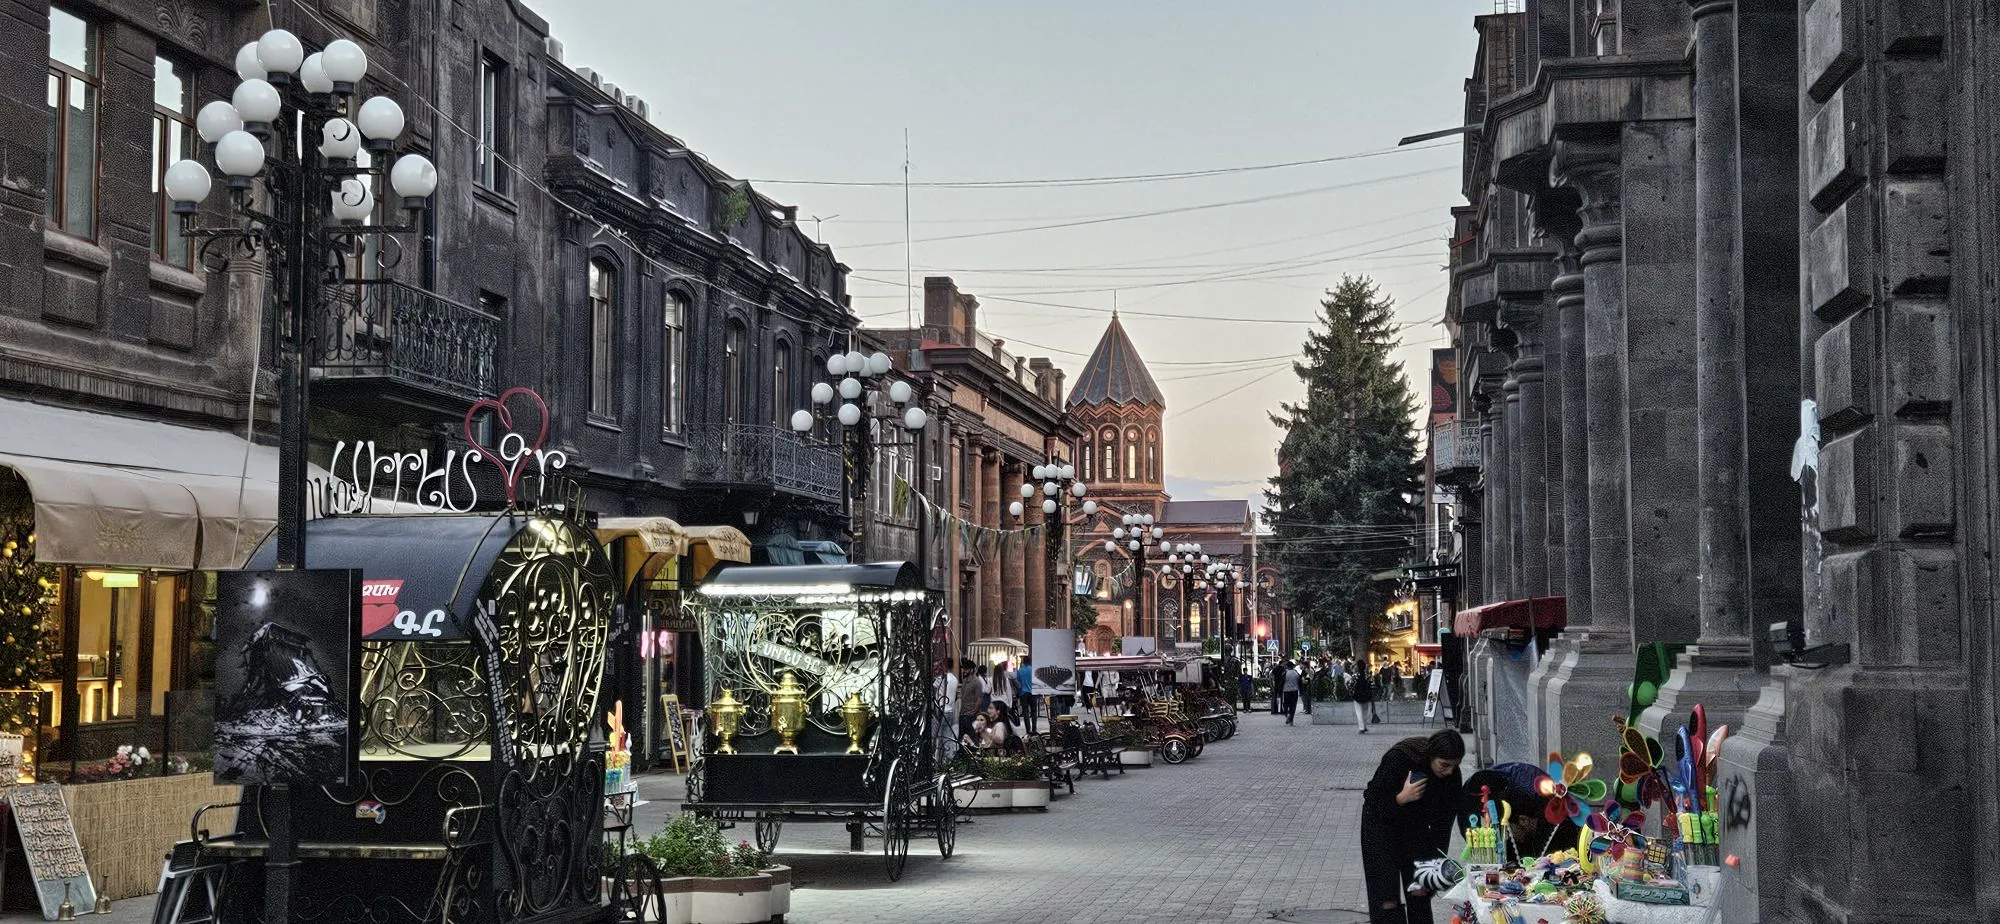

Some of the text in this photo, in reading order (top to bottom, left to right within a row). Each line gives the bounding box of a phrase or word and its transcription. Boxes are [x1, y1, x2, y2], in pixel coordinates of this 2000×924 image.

[393, 609, 446, 637] ԳԸ
[763, 643, 821, 673] ՍԻՐԵՄ ԳԸ
